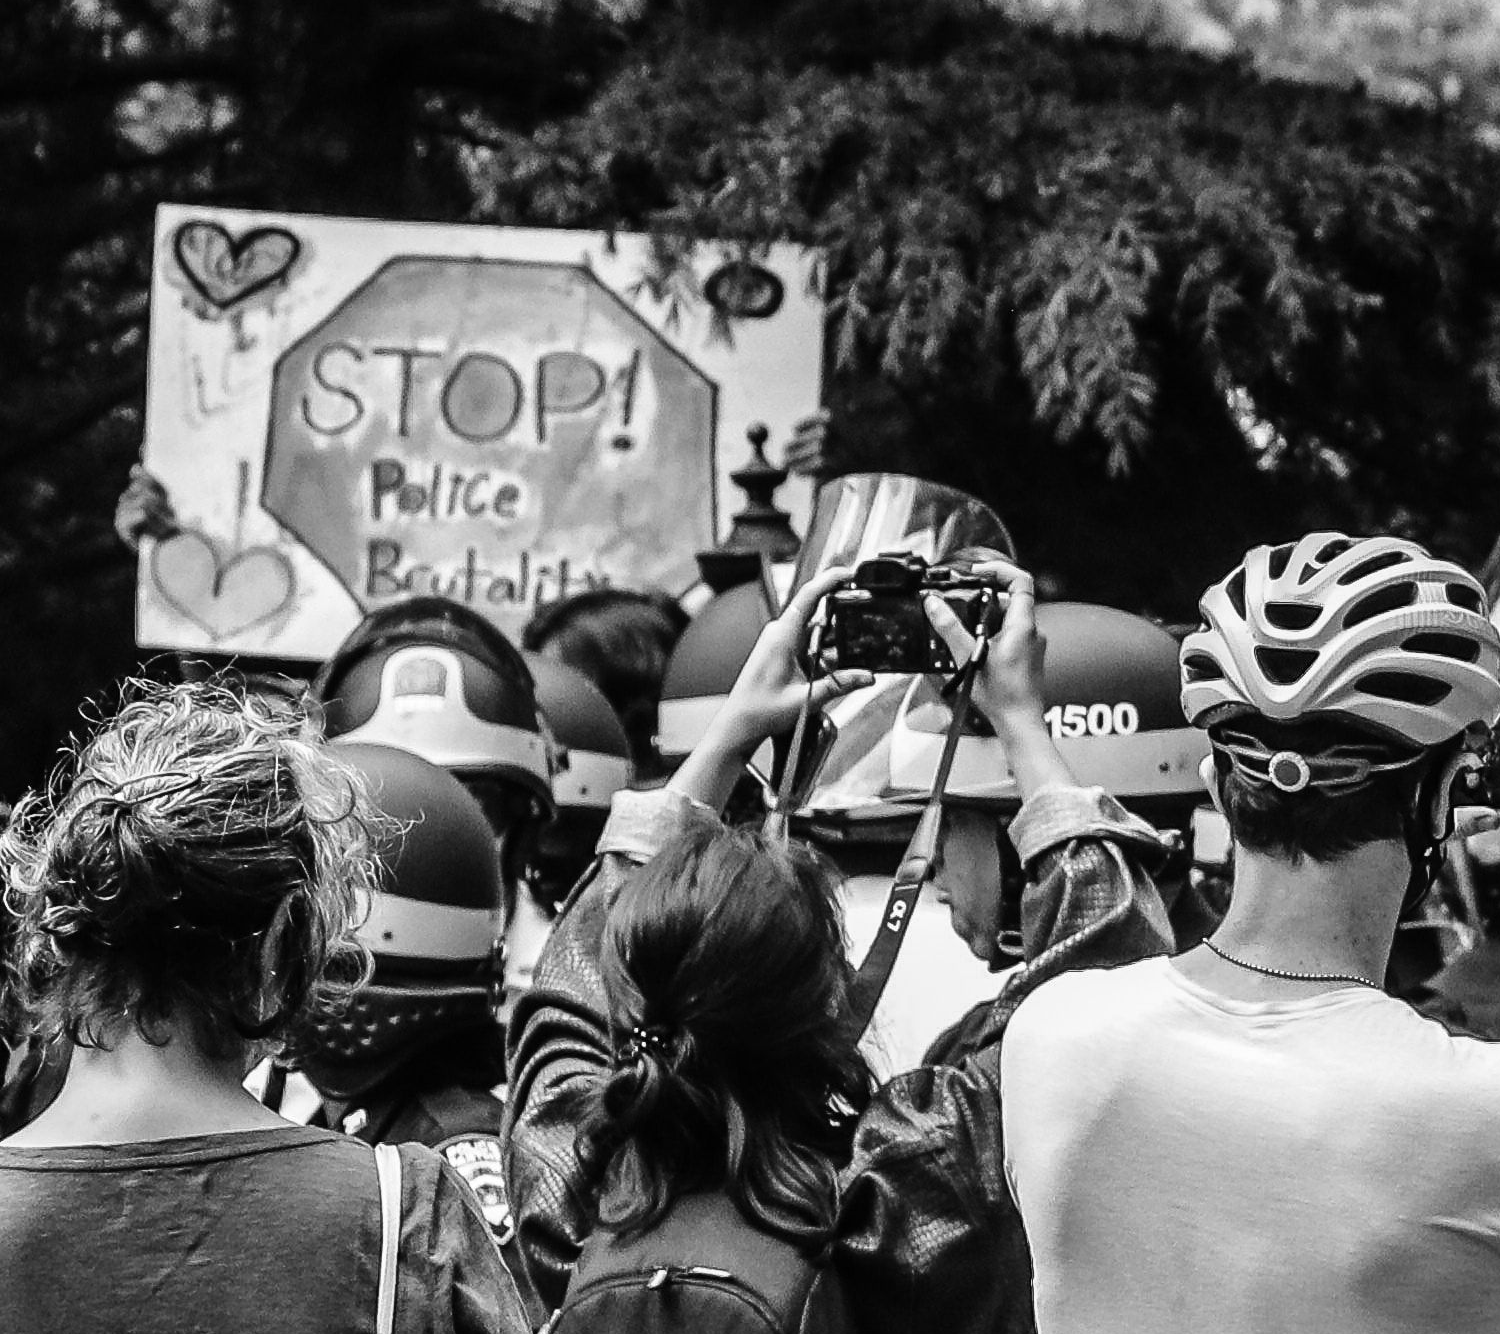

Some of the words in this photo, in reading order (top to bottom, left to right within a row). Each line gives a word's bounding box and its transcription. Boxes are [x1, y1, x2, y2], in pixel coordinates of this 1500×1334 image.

[302, 343, 640, 451] STOP!
[371, 458, 521, 524] Police
[1044, 702, 1138, 740] 1500
